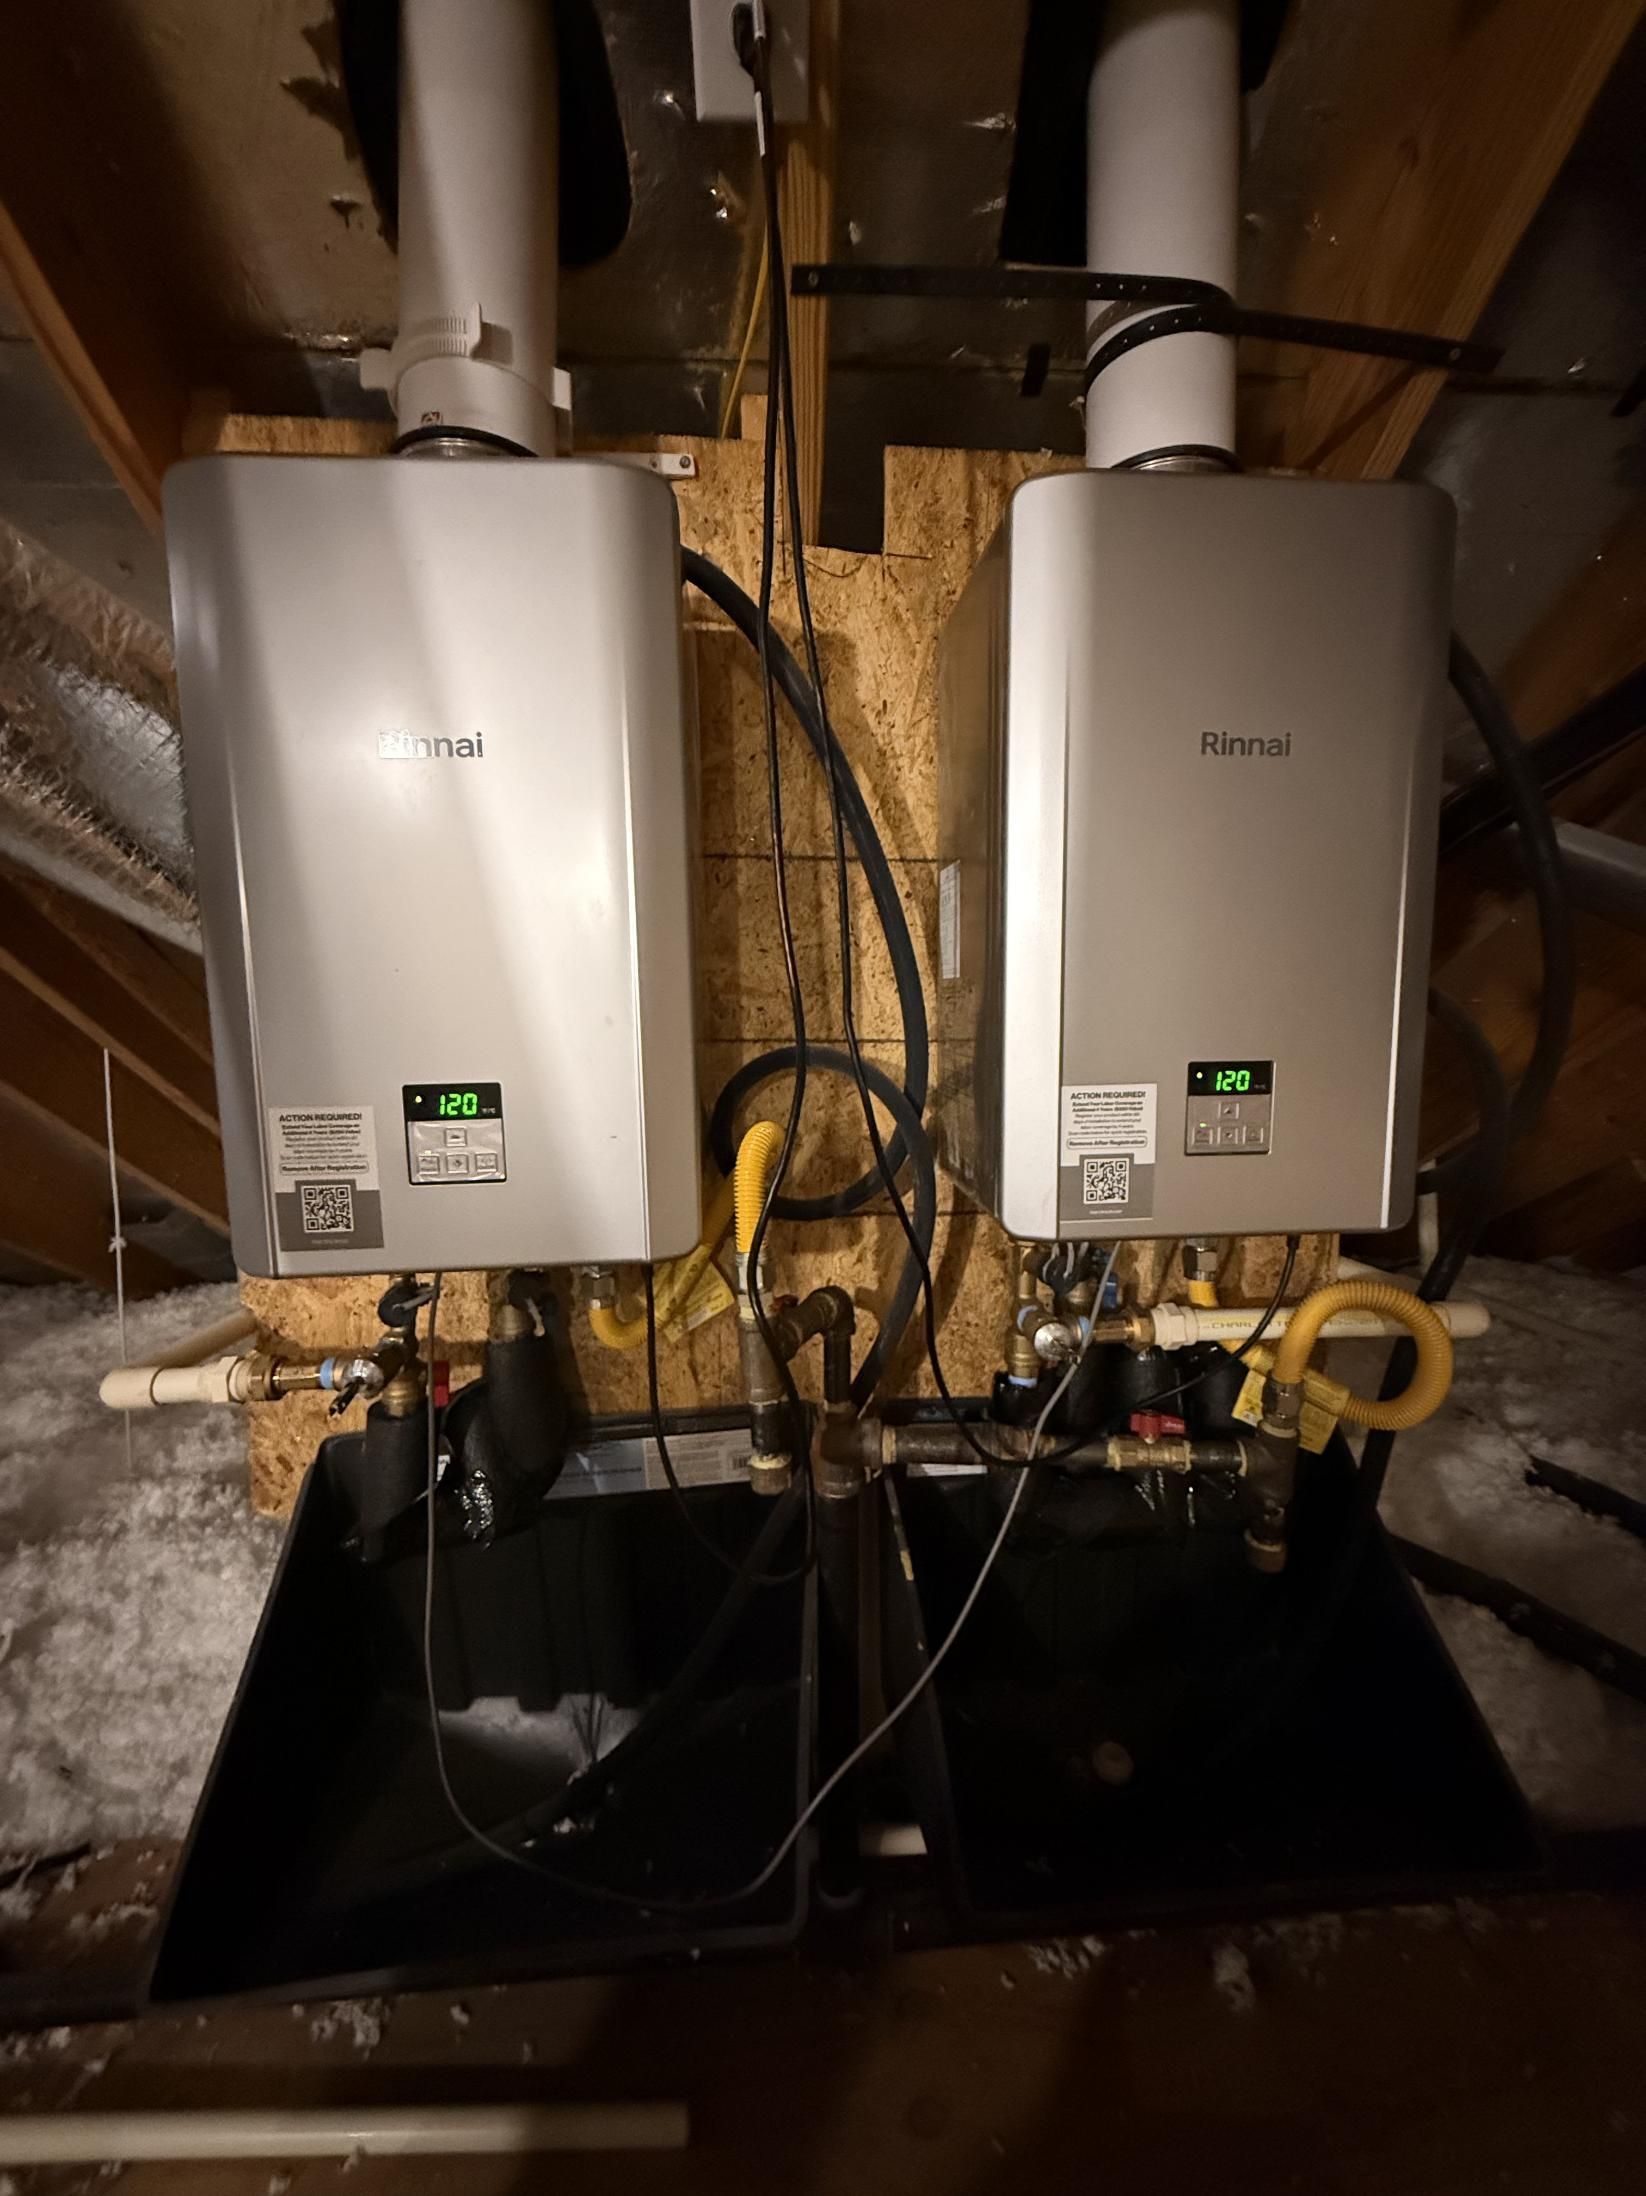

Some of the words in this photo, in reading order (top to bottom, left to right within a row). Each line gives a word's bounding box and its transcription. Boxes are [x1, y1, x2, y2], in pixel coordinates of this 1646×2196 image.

[1201, 731, 1292, 757] Rinnai
[1216, 1070, 1250, 1091] 120
[440, 1093, 478, 1115] 120
[1071, 1092, 1101, 1100] ACTION
[1103, 1091, 1146, 1099] REQUIRED!
[279, 1114, 313, 1122] ACTION
[315, 1113, 362, 1121] REQUIRED!
